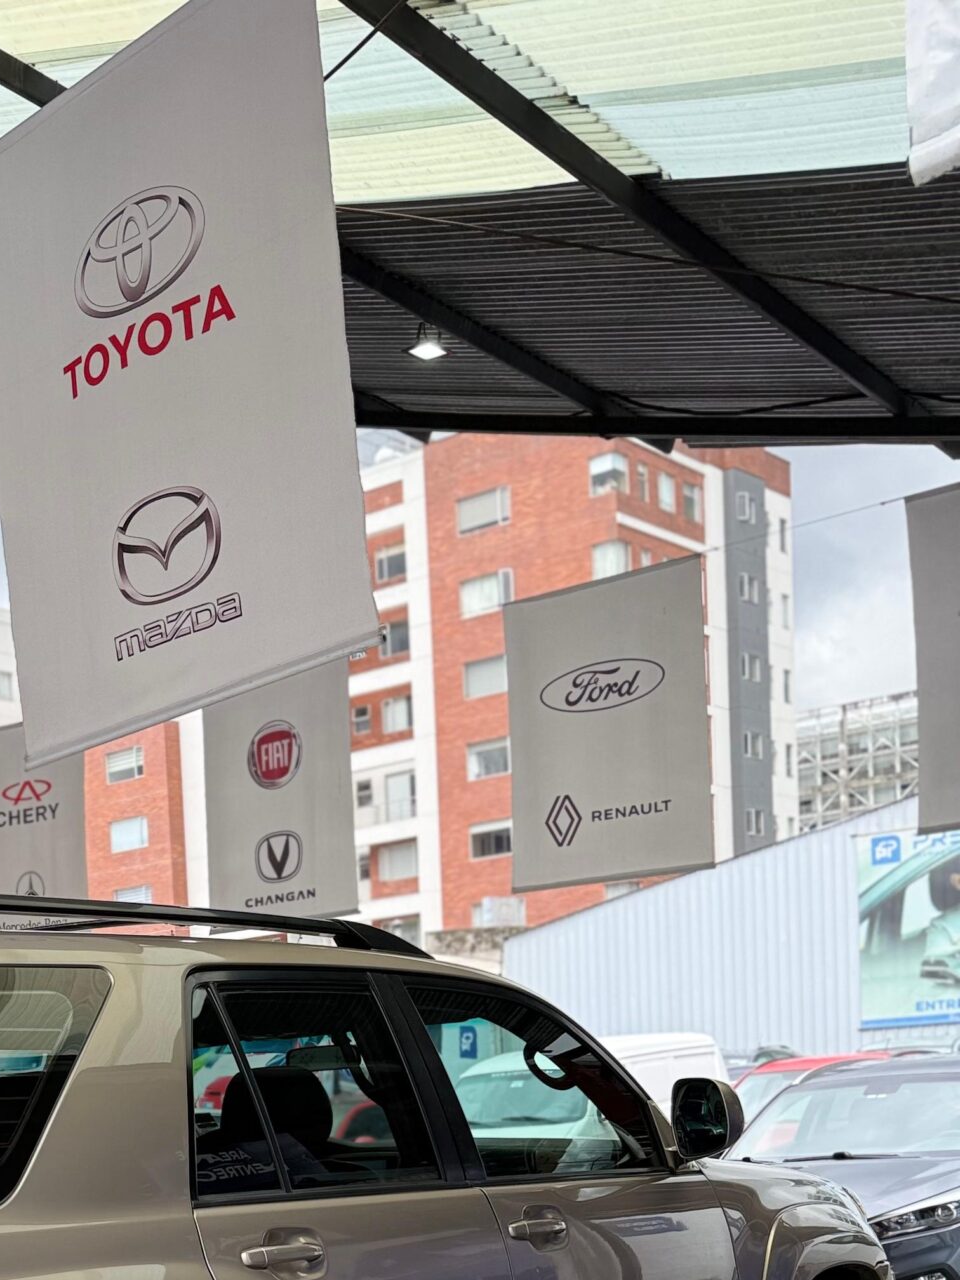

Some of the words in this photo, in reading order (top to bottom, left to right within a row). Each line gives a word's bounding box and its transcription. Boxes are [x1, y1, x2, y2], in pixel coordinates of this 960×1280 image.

[62, 284, 237, 399] TOYOTA
[114, 591, 243, 661] mazda
[564, 666, 641, 708] Ford
[260, 738, 290, 772] FIAT
[590, 799, 672, 823] RENAULT
[245, 888, 316, 908] CHANGAN
